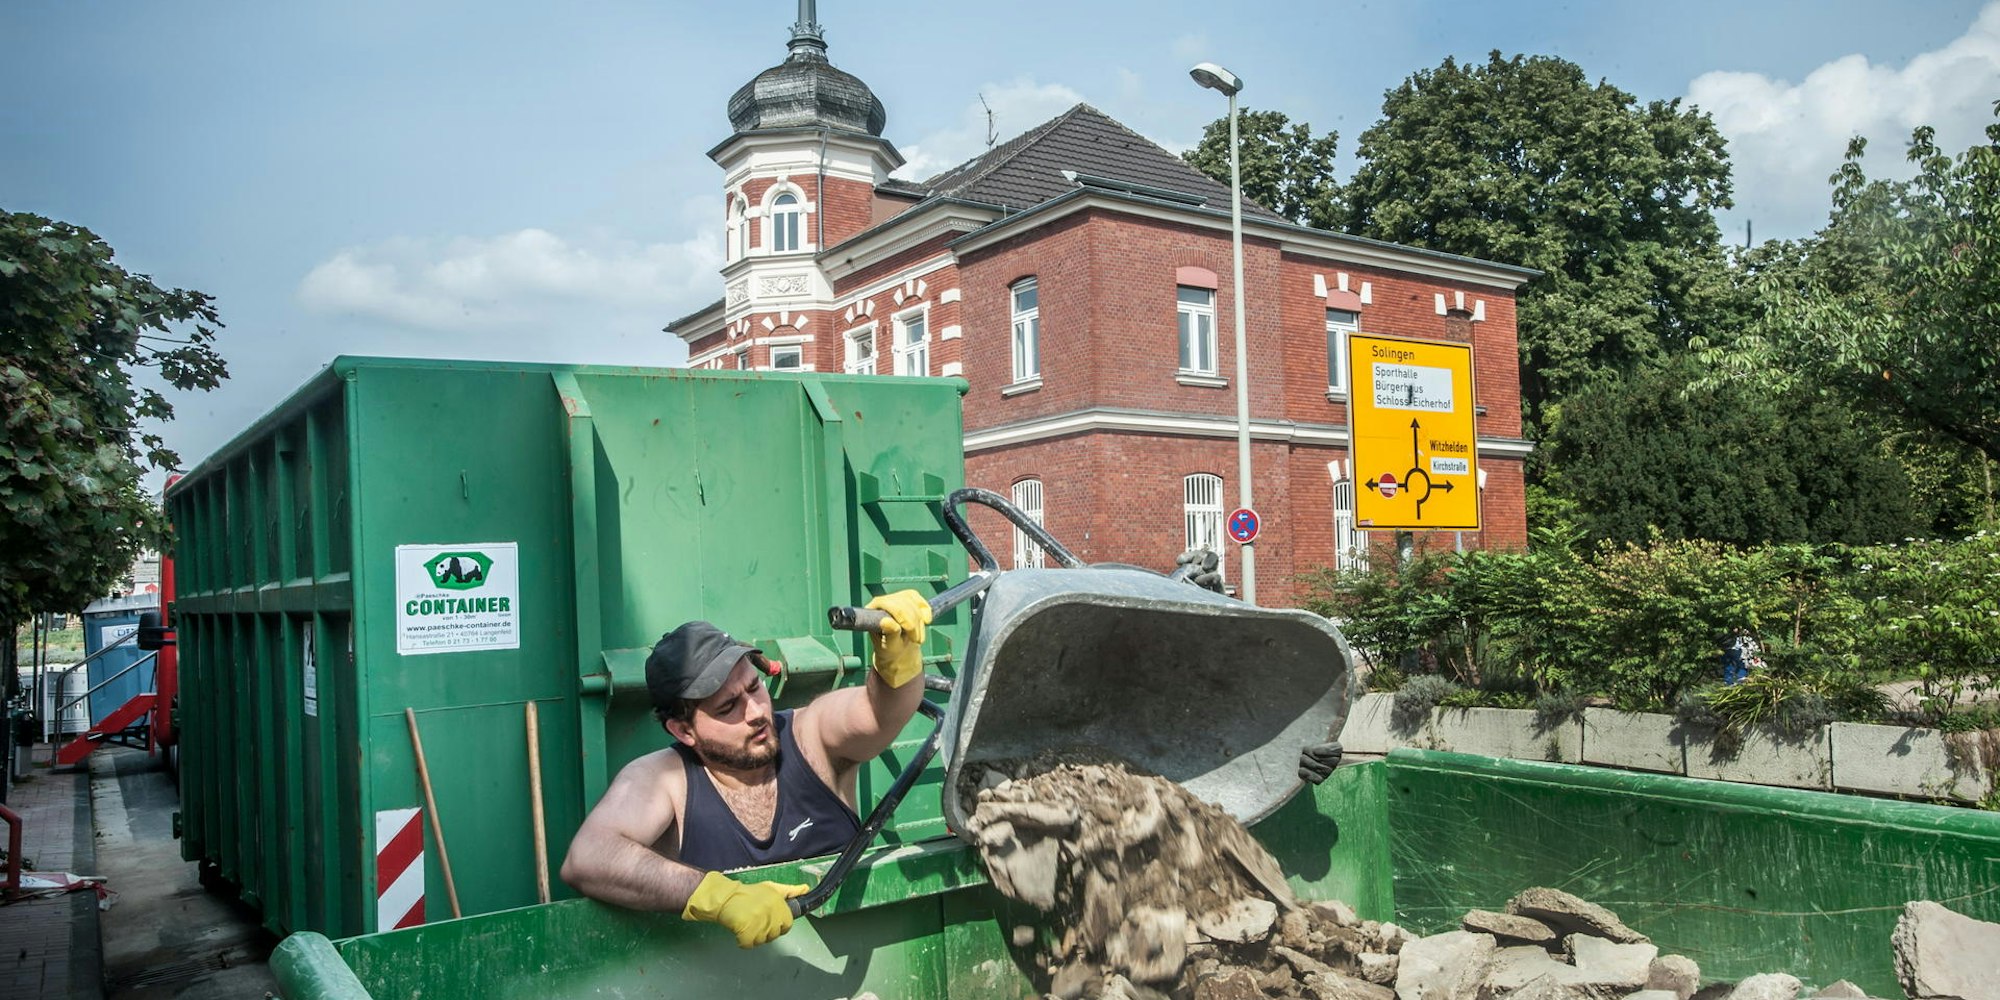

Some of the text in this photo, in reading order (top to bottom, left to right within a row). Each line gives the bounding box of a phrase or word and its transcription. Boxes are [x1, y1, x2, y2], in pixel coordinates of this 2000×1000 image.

[1372, 345, 1415, 362] Solingen
[1375, 366, 1418, 379] Sporthalle
[1375, 380, 1424, 393] Bürgerhus
[1376, 394, 1451, 409] Schloss Eicherhof
[1429, 440, 1468, 453] Witzhelden
[1433, 460, 1467, 472] Kirchstraße
[406, 597, 510, 616] CONTAINER
[406, 621, 512, 632] www.paeschke-container.de
